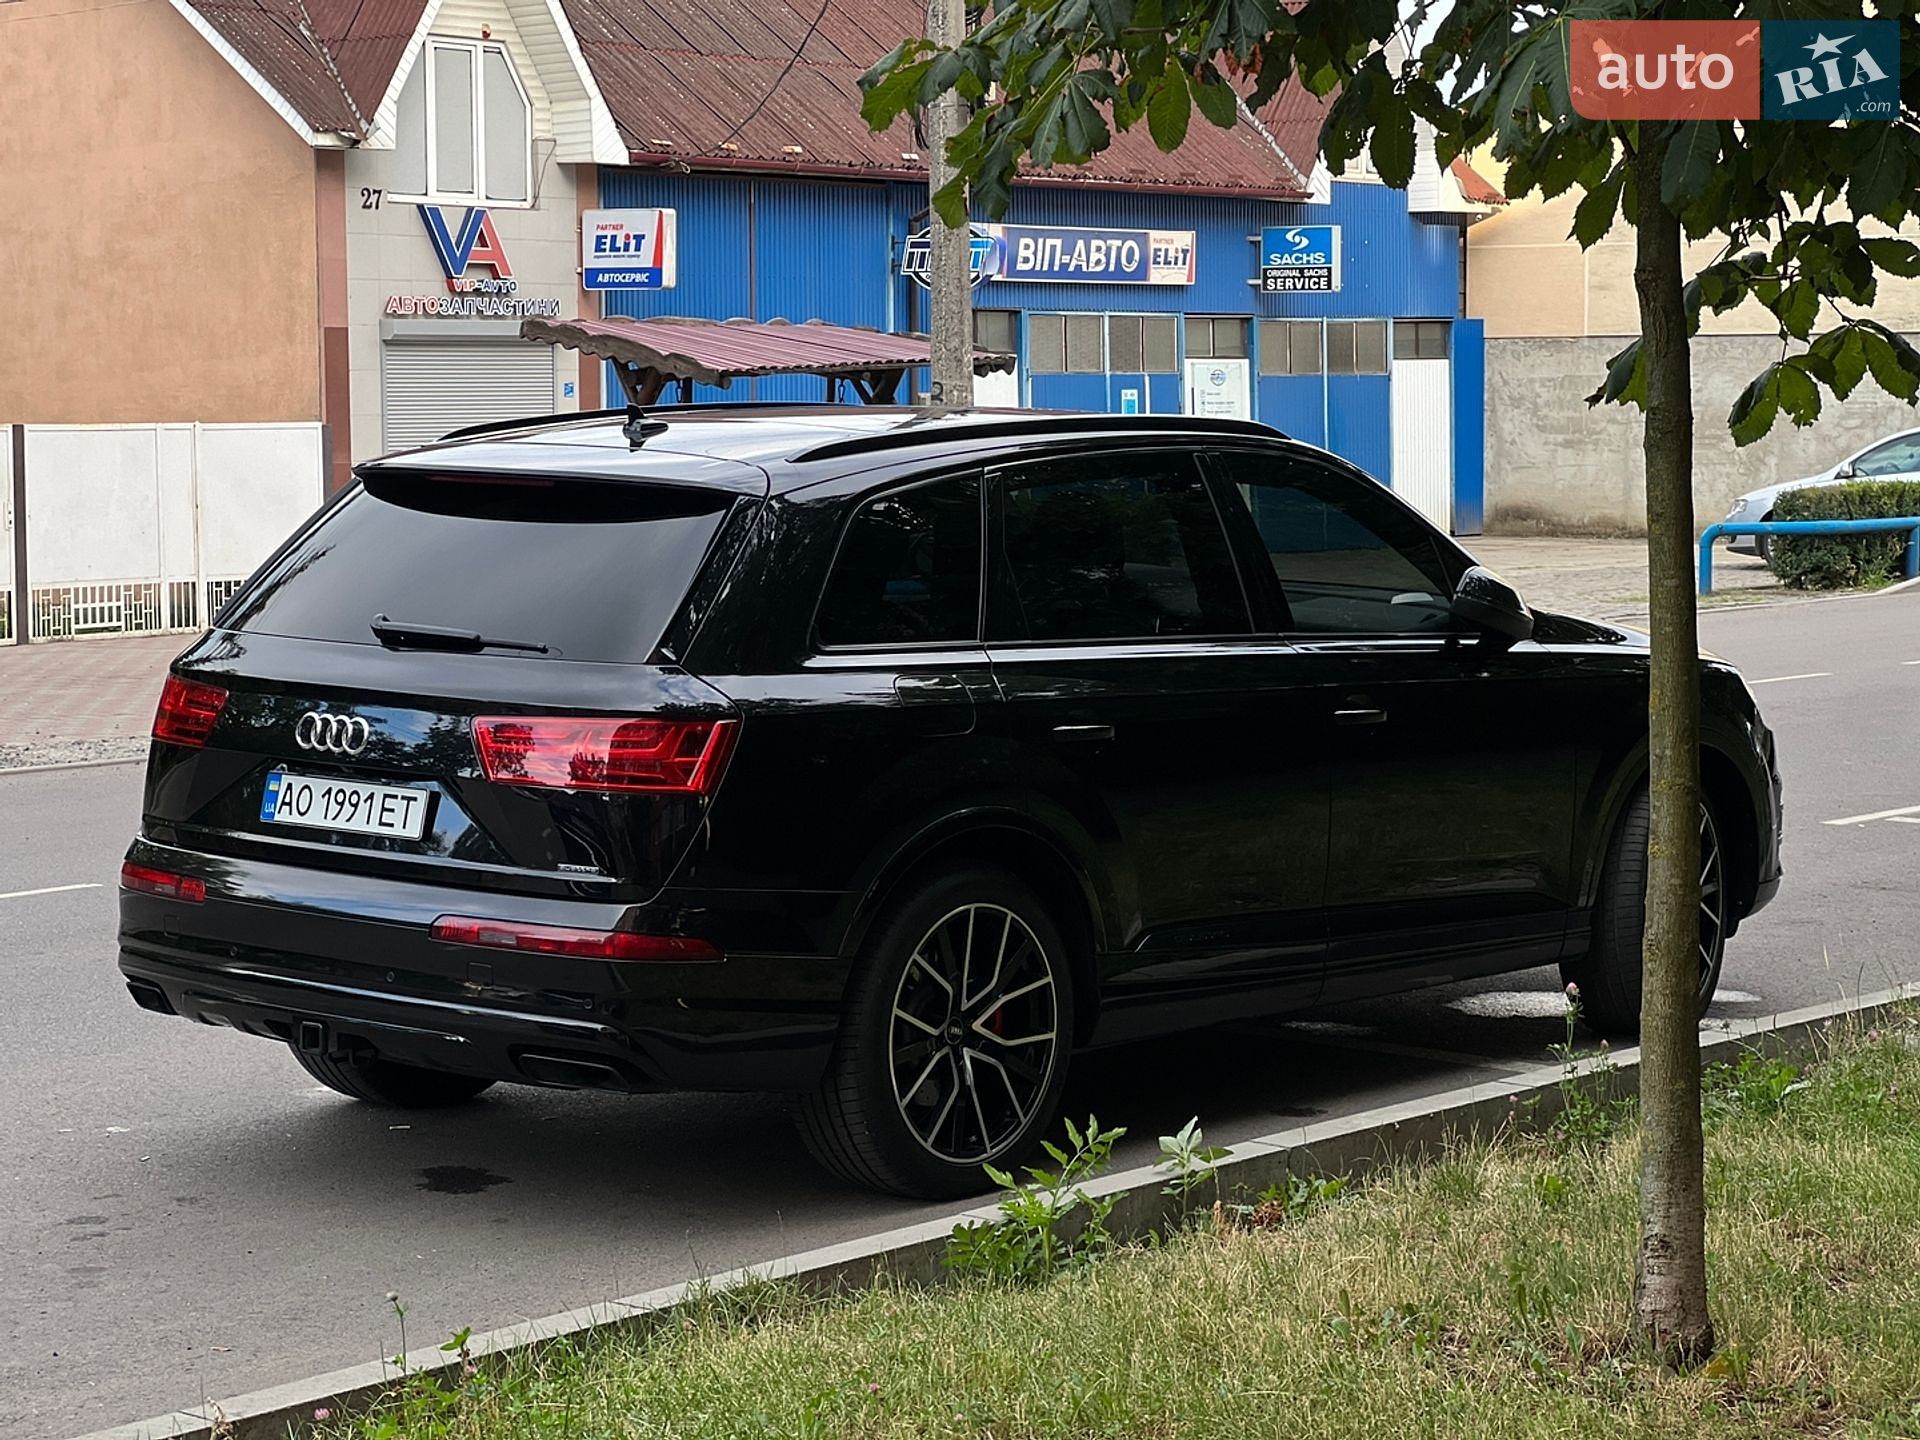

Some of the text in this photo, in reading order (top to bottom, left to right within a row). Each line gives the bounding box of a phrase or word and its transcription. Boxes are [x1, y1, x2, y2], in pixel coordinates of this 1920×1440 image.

[361, 187, 383, 210] 27
[596, 223, 624, 231] PARTNER
[416, 204, 514, 279] VA
[1016, 237, 1140, 273] ВІП-АВТО
[1269, 251, 1326, 266] SACHS
[596, 272, 651, 283] АВТОСЕРВІС
[1266, 268, 1329, 277] ORIGINAL SACHS
[1266, 277, 1328, 290] SERVICE
[277, 782, 313, 817] AO
